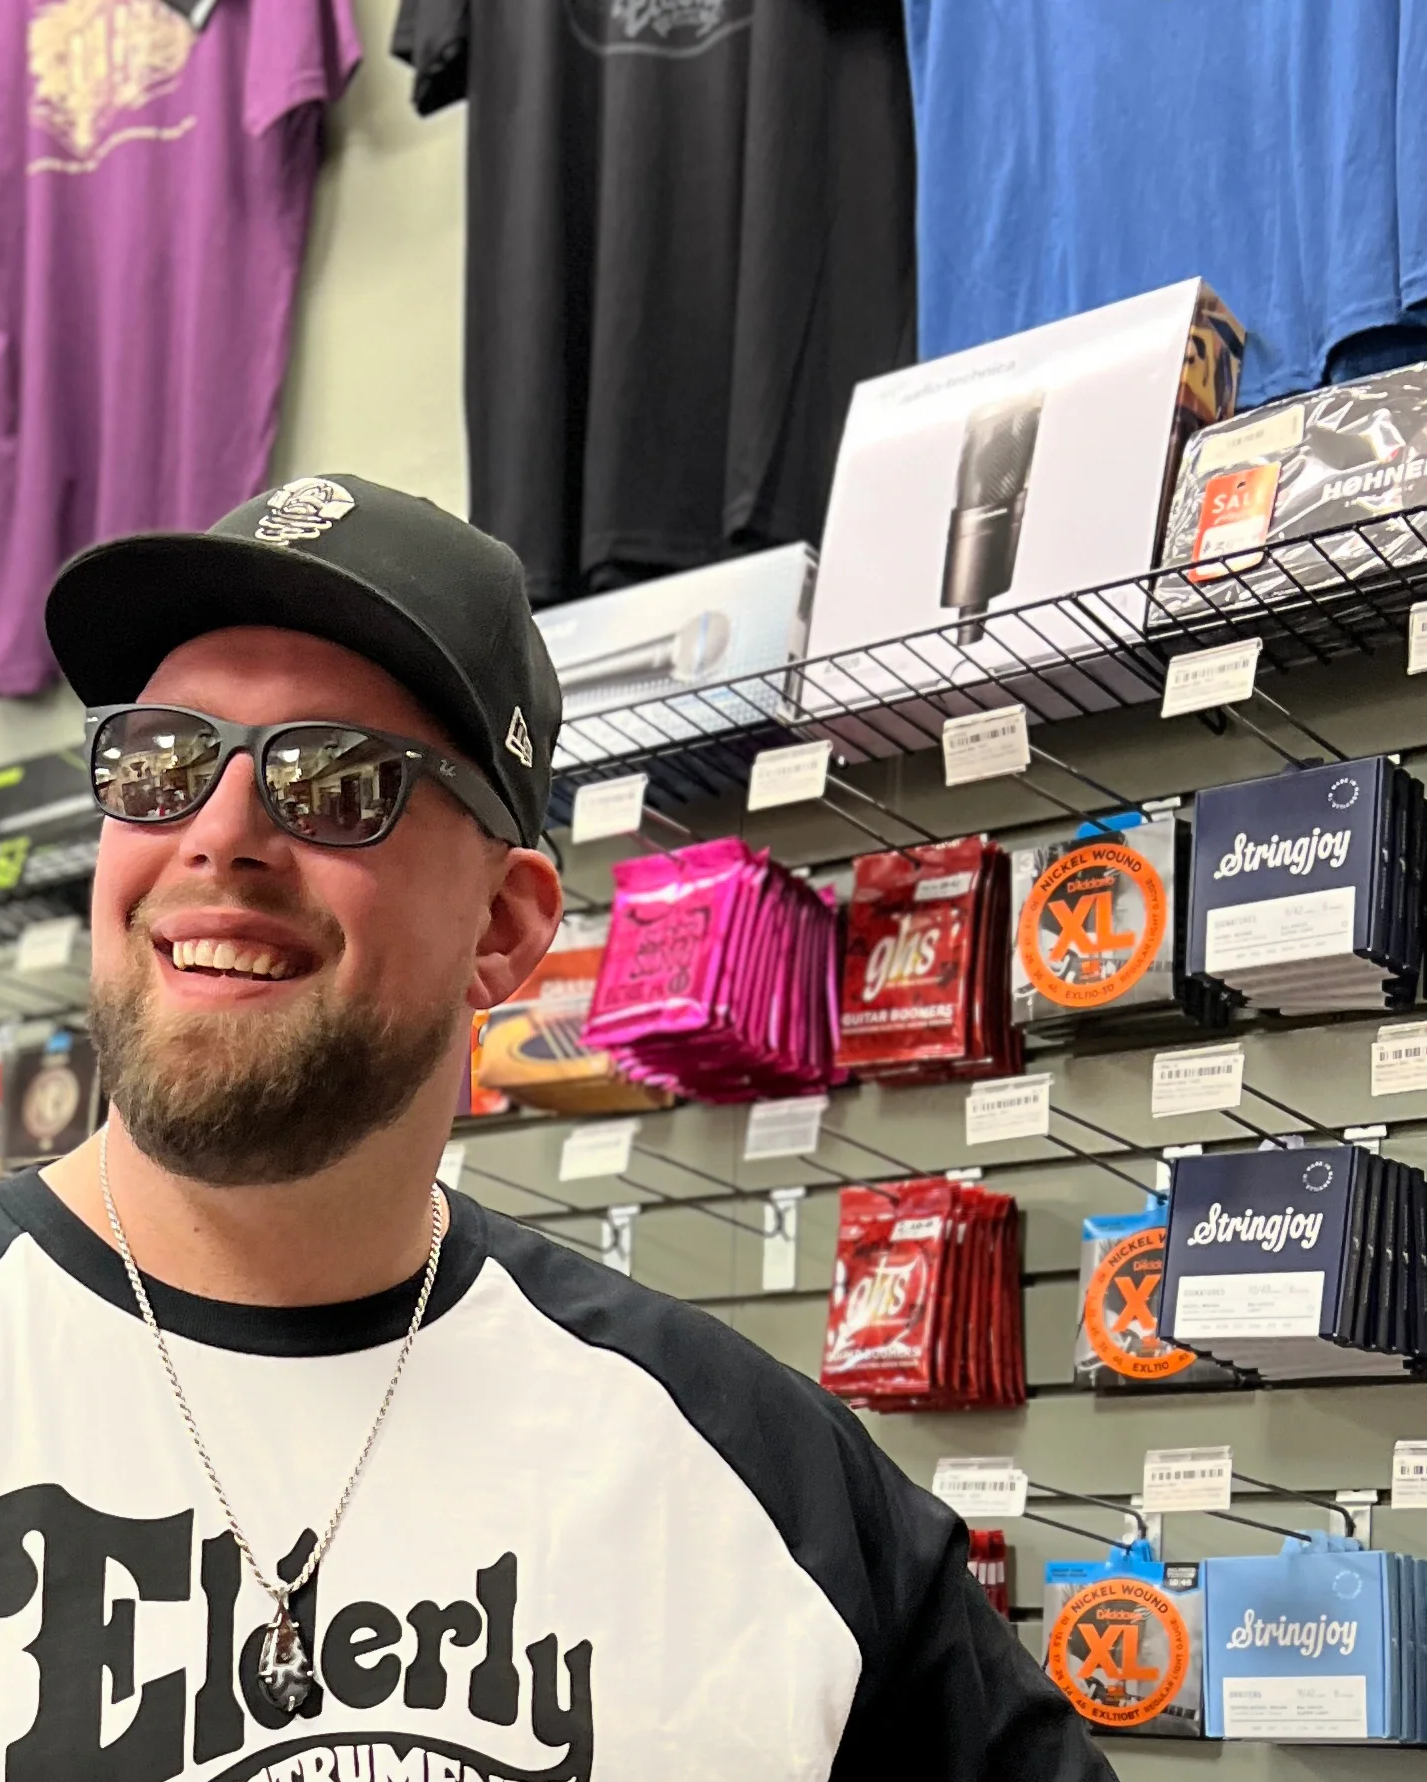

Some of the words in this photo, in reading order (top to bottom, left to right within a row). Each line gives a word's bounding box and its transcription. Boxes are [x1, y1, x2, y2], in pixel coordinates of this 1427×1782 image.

[1211, 490, 1259, 514] SAL
[1321, 456, 1427, 500] HOHNE
[1040, 854, 1087, 891] NICKEL
[1092, 849, 1142, 872] WOUND
[1213, 827, 1351, 880] Stringjoy
[1048, 891, 1135, 962] XL
[862, 912, 941, 1002] ghs
[841, 1010, 888, 1027] GUITAR
[890, 1004, 953, 1021] BOOMERS
[1108, 1235, 1154, 1268] NICKEL
[1187, 1202, 1323, 1252] Stringjoy
[1112, 1274, 1162, 1332] X
[1071, 1586, 1117, 1613] NICKEL
[1121, 1585, 1168, 1614] WOUND
[1077, 1624, 1159, 1680] XL
[1226, 1609, 1357, 1658] Stringjoy
[1144, 1681, 1174, 1713] REGULAR
[1173, 1653, 1183, 1680] LIGHT
